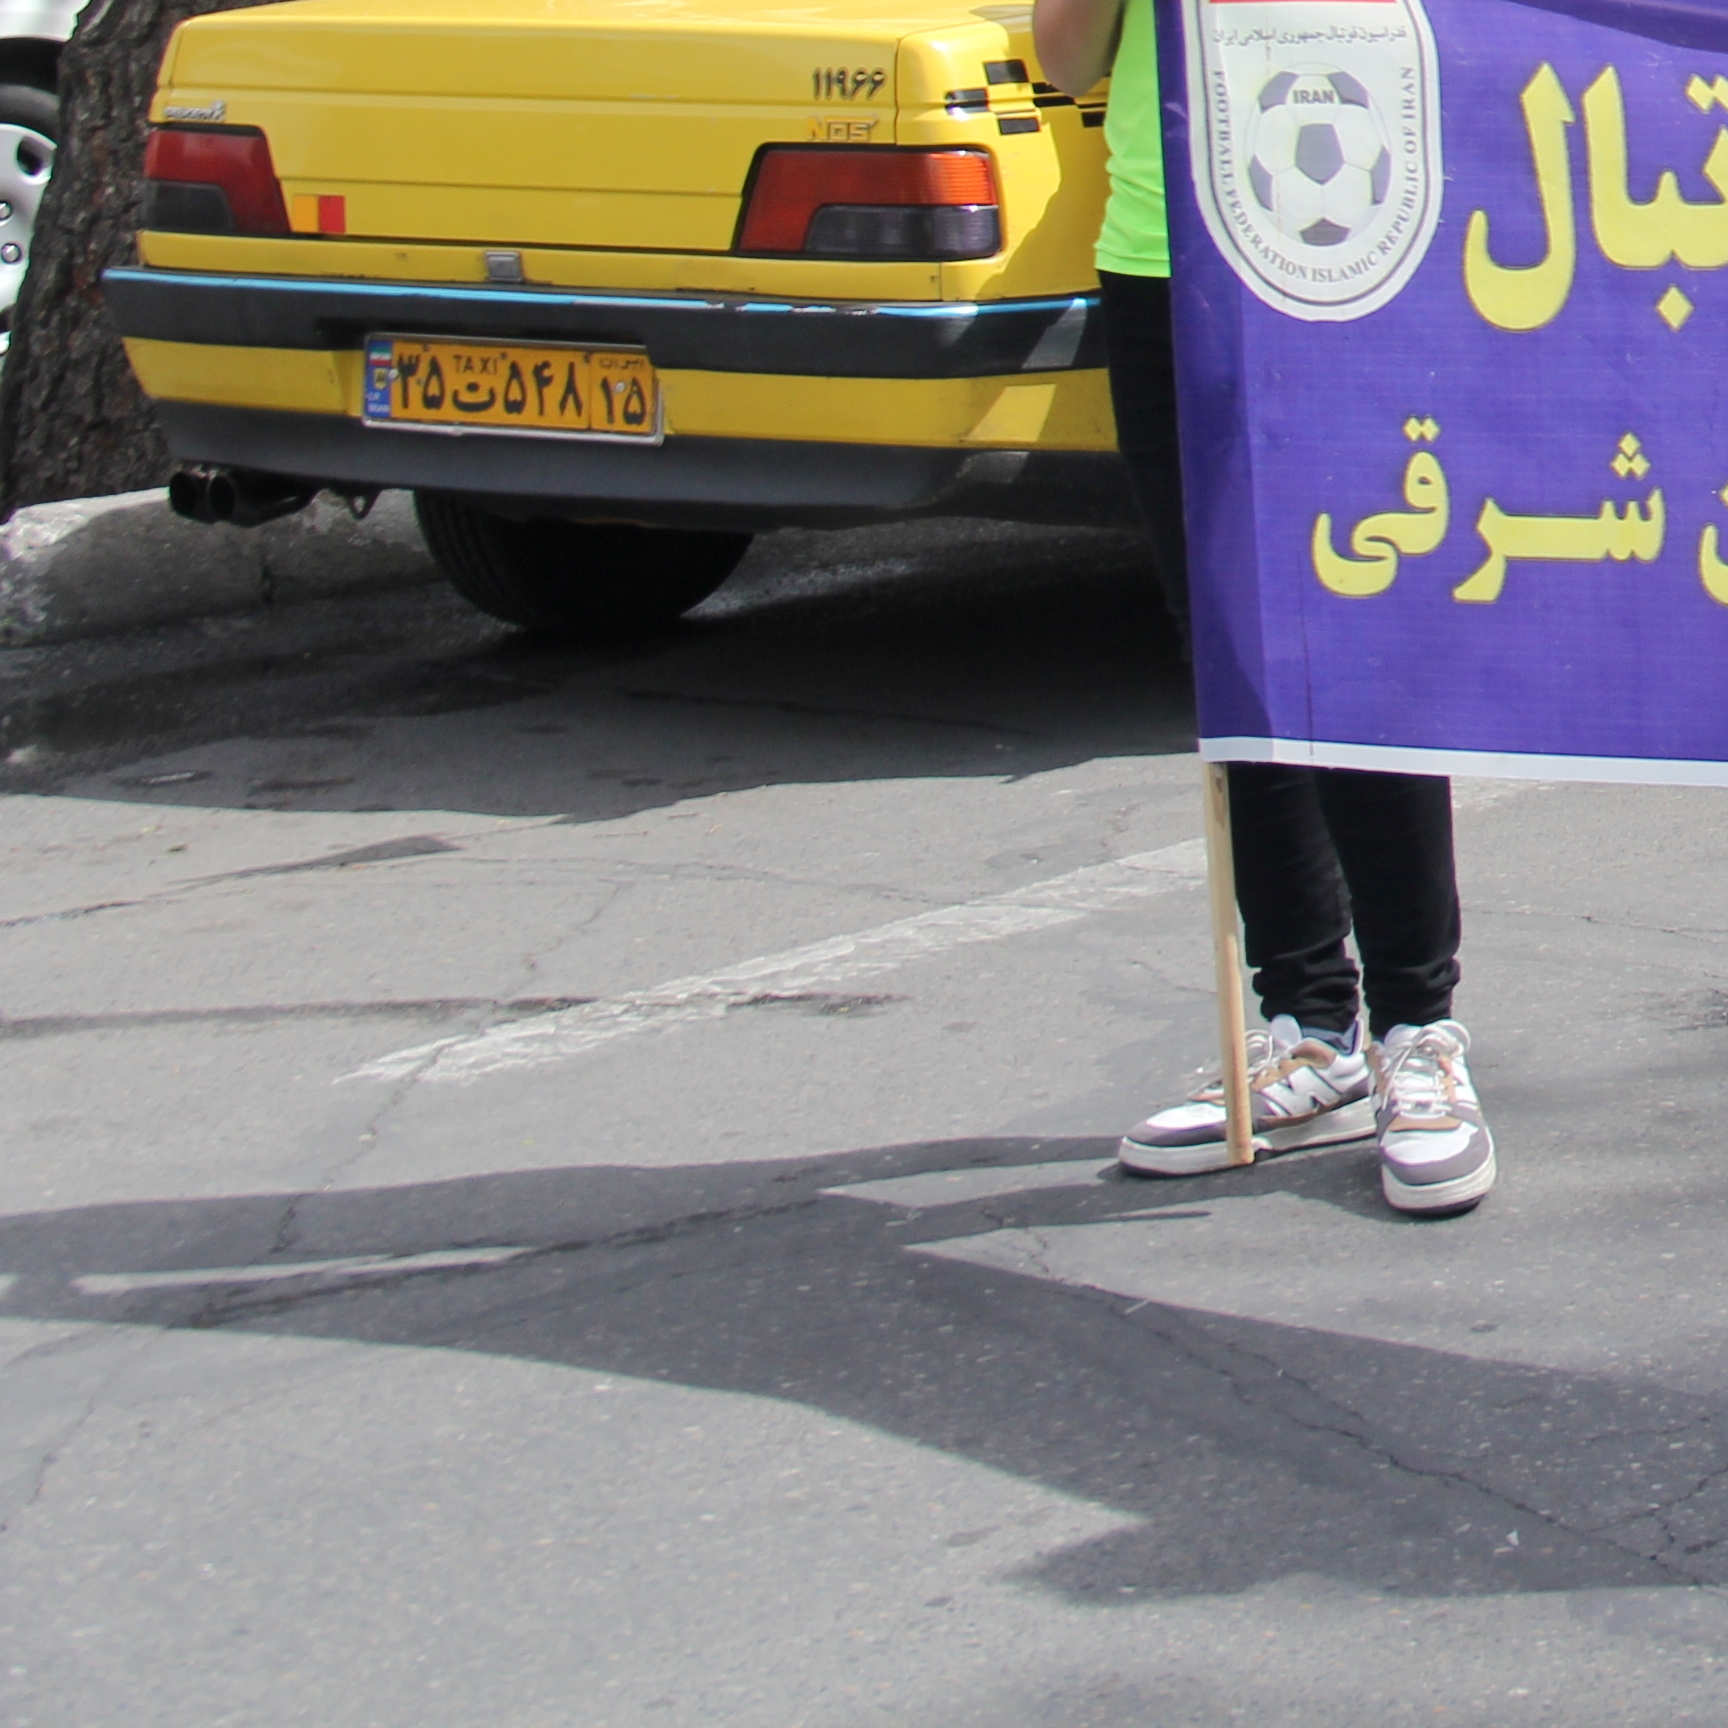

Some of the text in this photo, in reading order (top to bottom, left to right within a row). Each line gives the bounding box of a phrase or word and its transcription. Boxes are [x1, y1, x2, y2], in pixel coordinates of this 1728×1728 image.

[1292, 88, 1336, 105] IRAN
[1400, 66, 1417, 122] IRAN
[1403, 126, 1418, 156] OF
[1377, 159, 1419, 257] REPUBLIC
[1310, 250, 1379, 283] ISLAMIC
[452, 353, 499, 375] TAXI
[1312, 419, 1662, 602] شرقی
